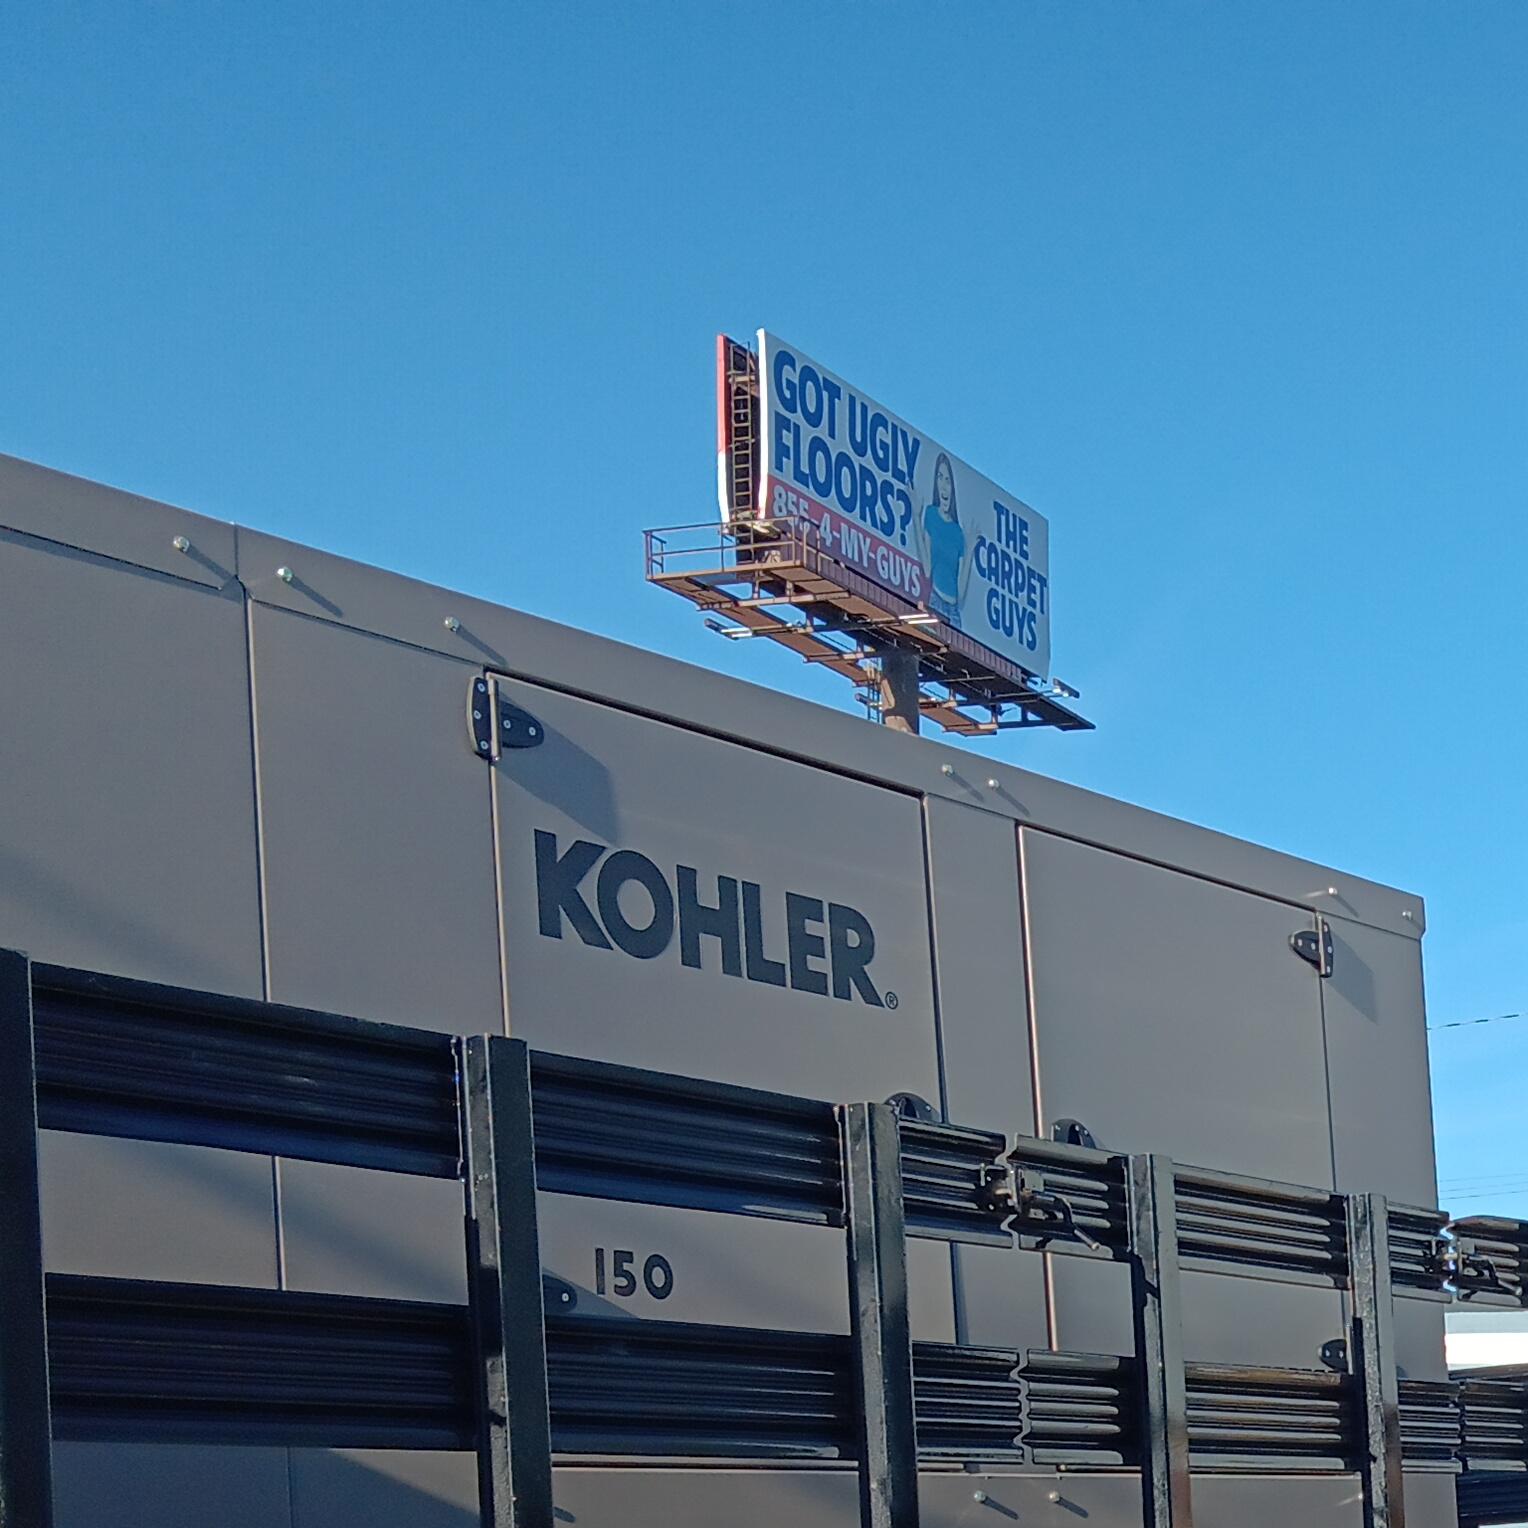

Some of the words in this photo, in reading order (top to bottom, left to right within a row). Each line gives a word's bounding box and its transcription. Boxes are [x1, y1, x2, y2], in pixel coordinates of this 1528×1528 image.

[773, 349, 841, 439] GOT
[848, 395, 920, 489] UGLY
[775, 411, 913, 546] FLOORS?
[993, 500, 1029, 559] THE
[974, 535, 1048, 616] CARPET
[986, 587, 1037, 652] GUYS
[533, 828, 886, 1009] KOHLER
[595, 1248, 674, 1300] 150
